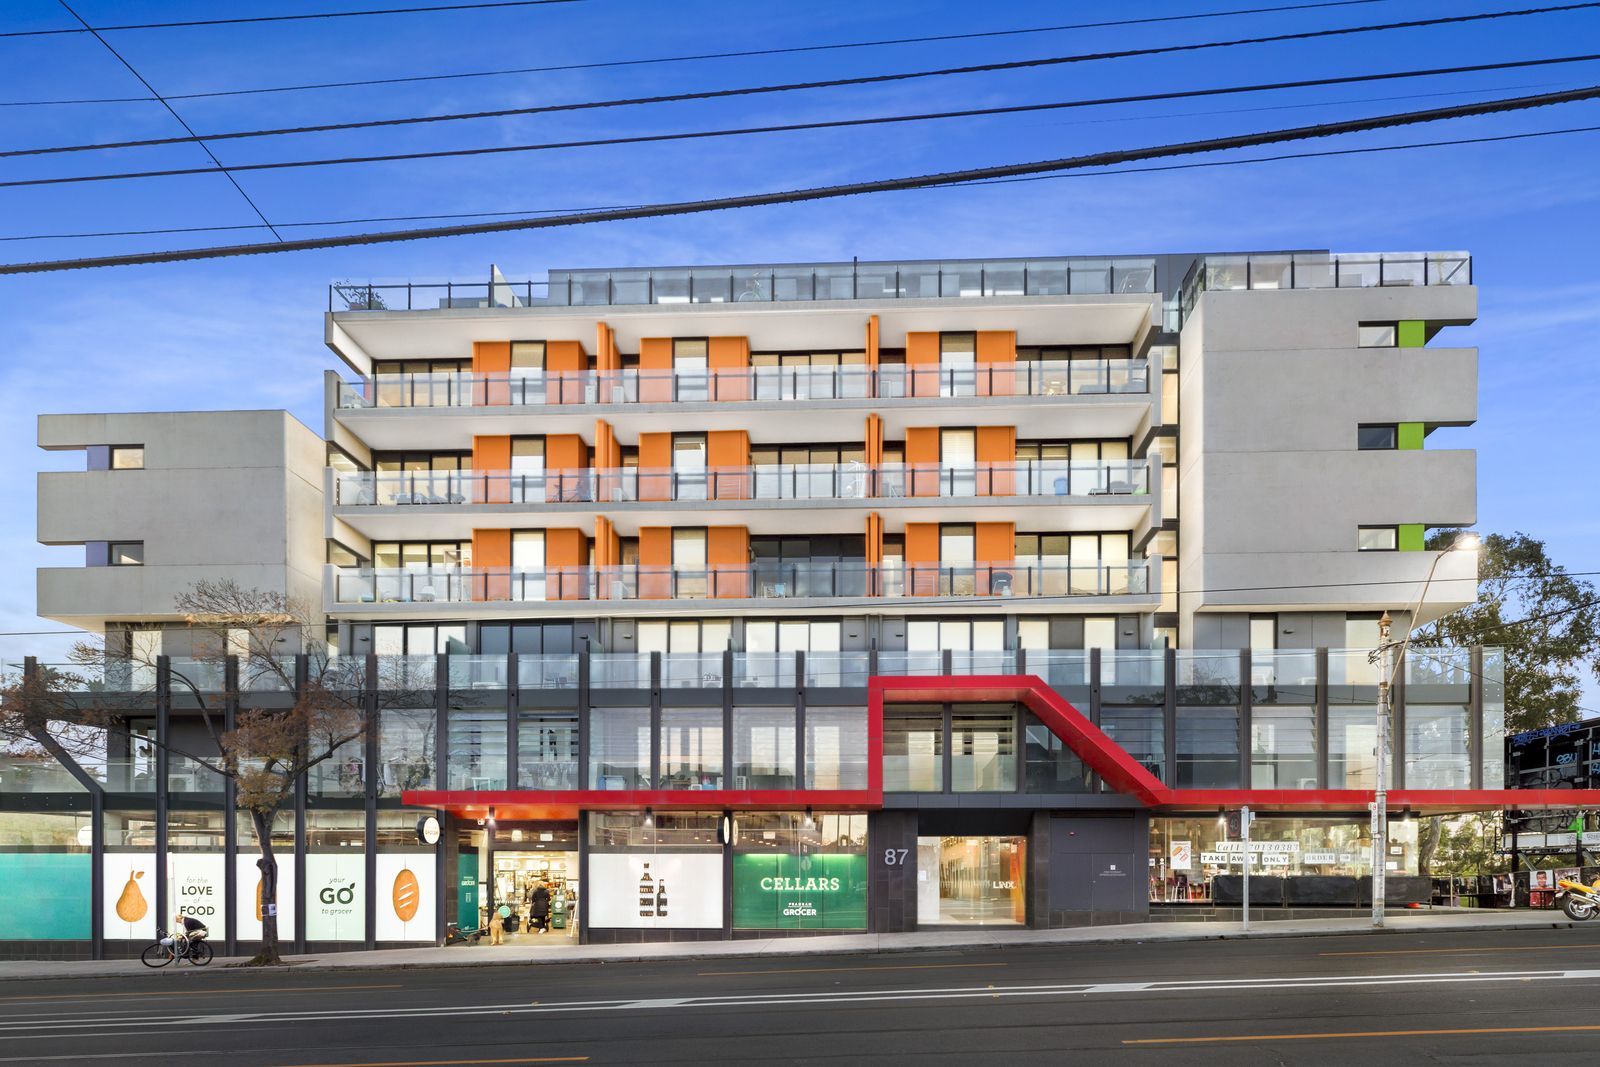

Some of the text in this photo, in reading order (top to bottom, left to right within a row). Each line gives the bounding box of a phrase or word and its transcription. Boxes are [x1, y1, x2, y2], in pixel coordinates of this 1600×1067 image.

[884, 848, 909, 865] 87
[760, 877, 840, 891] CELLARS
[181, 885, 213, 896] LOVE
[319, 887, 354, 905] GO
[180, 905, 215, 916] FOOD
[783, 907, 817, 916] GROCER
